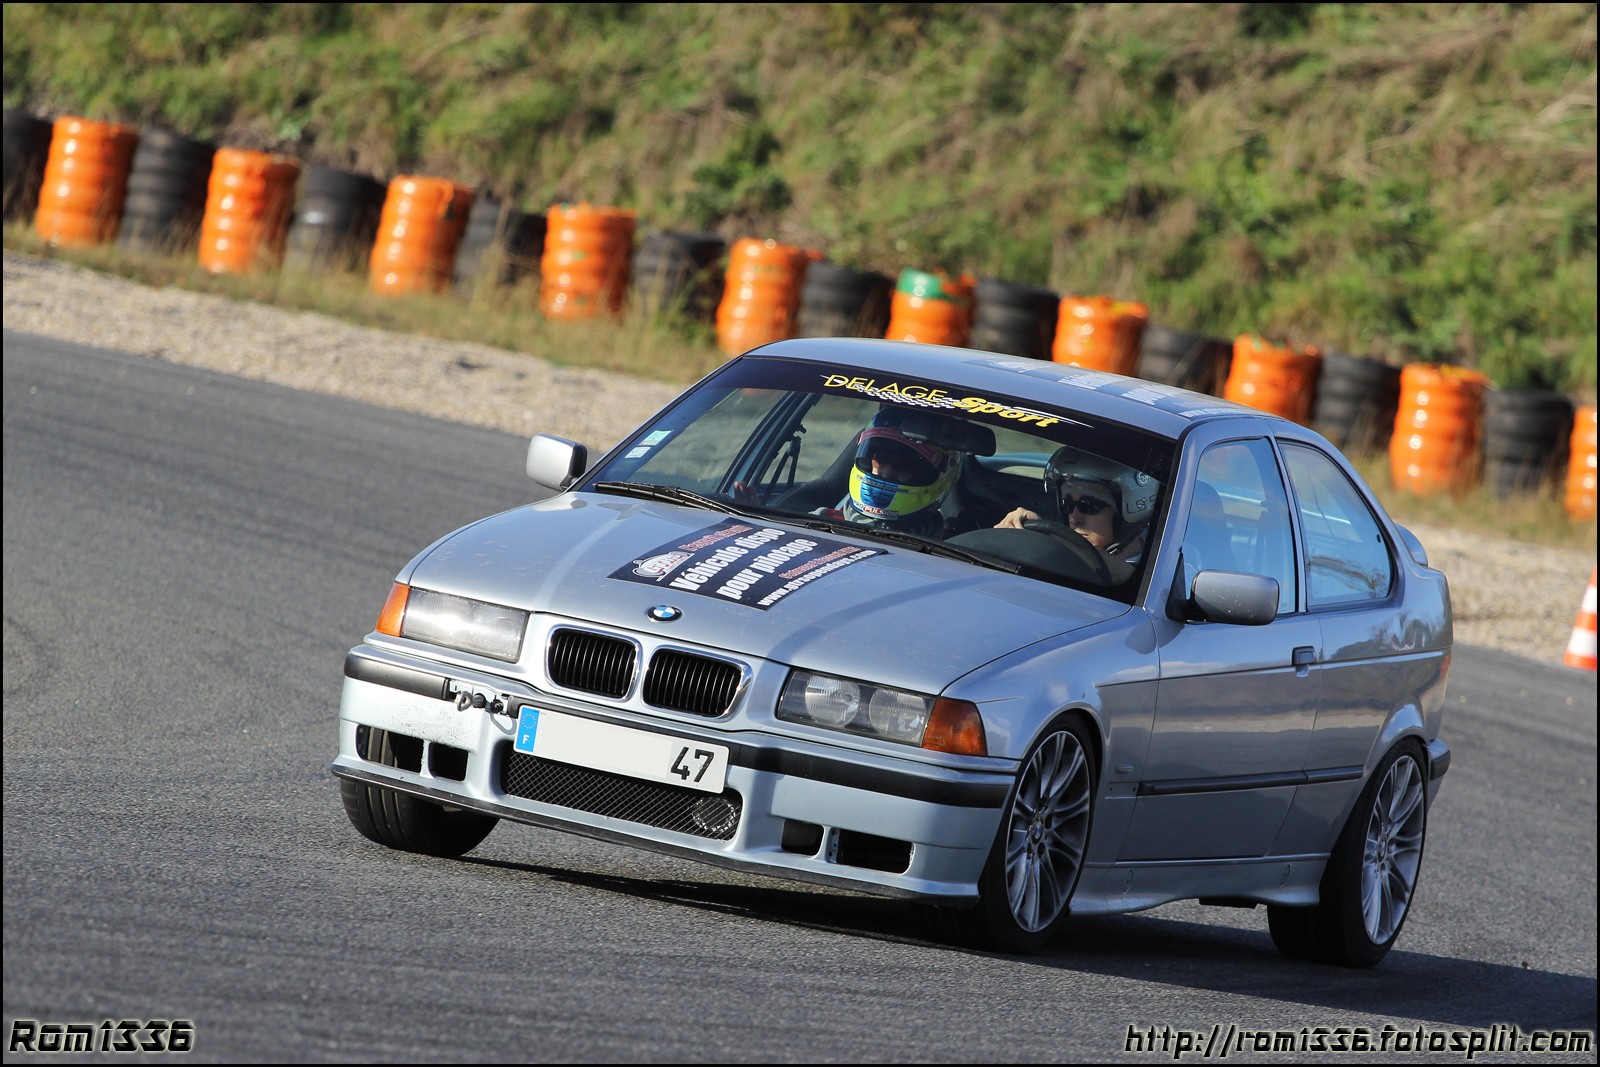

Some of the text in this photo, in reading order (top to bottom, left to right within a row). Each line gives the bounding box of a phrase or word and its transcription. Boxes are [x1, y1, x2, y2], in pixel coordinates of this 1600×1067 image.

[823, 374, 1061, 428] DELAGE Sport
[669, 545, 749, 591] Véhicule
[734, 528, 786, 550] dispo
[716, 568, 764, 600] pour
[752, 538, 818, 574] pilotage
[522, 734, 530, 744] F
[670, 746, 715, 783] 47
